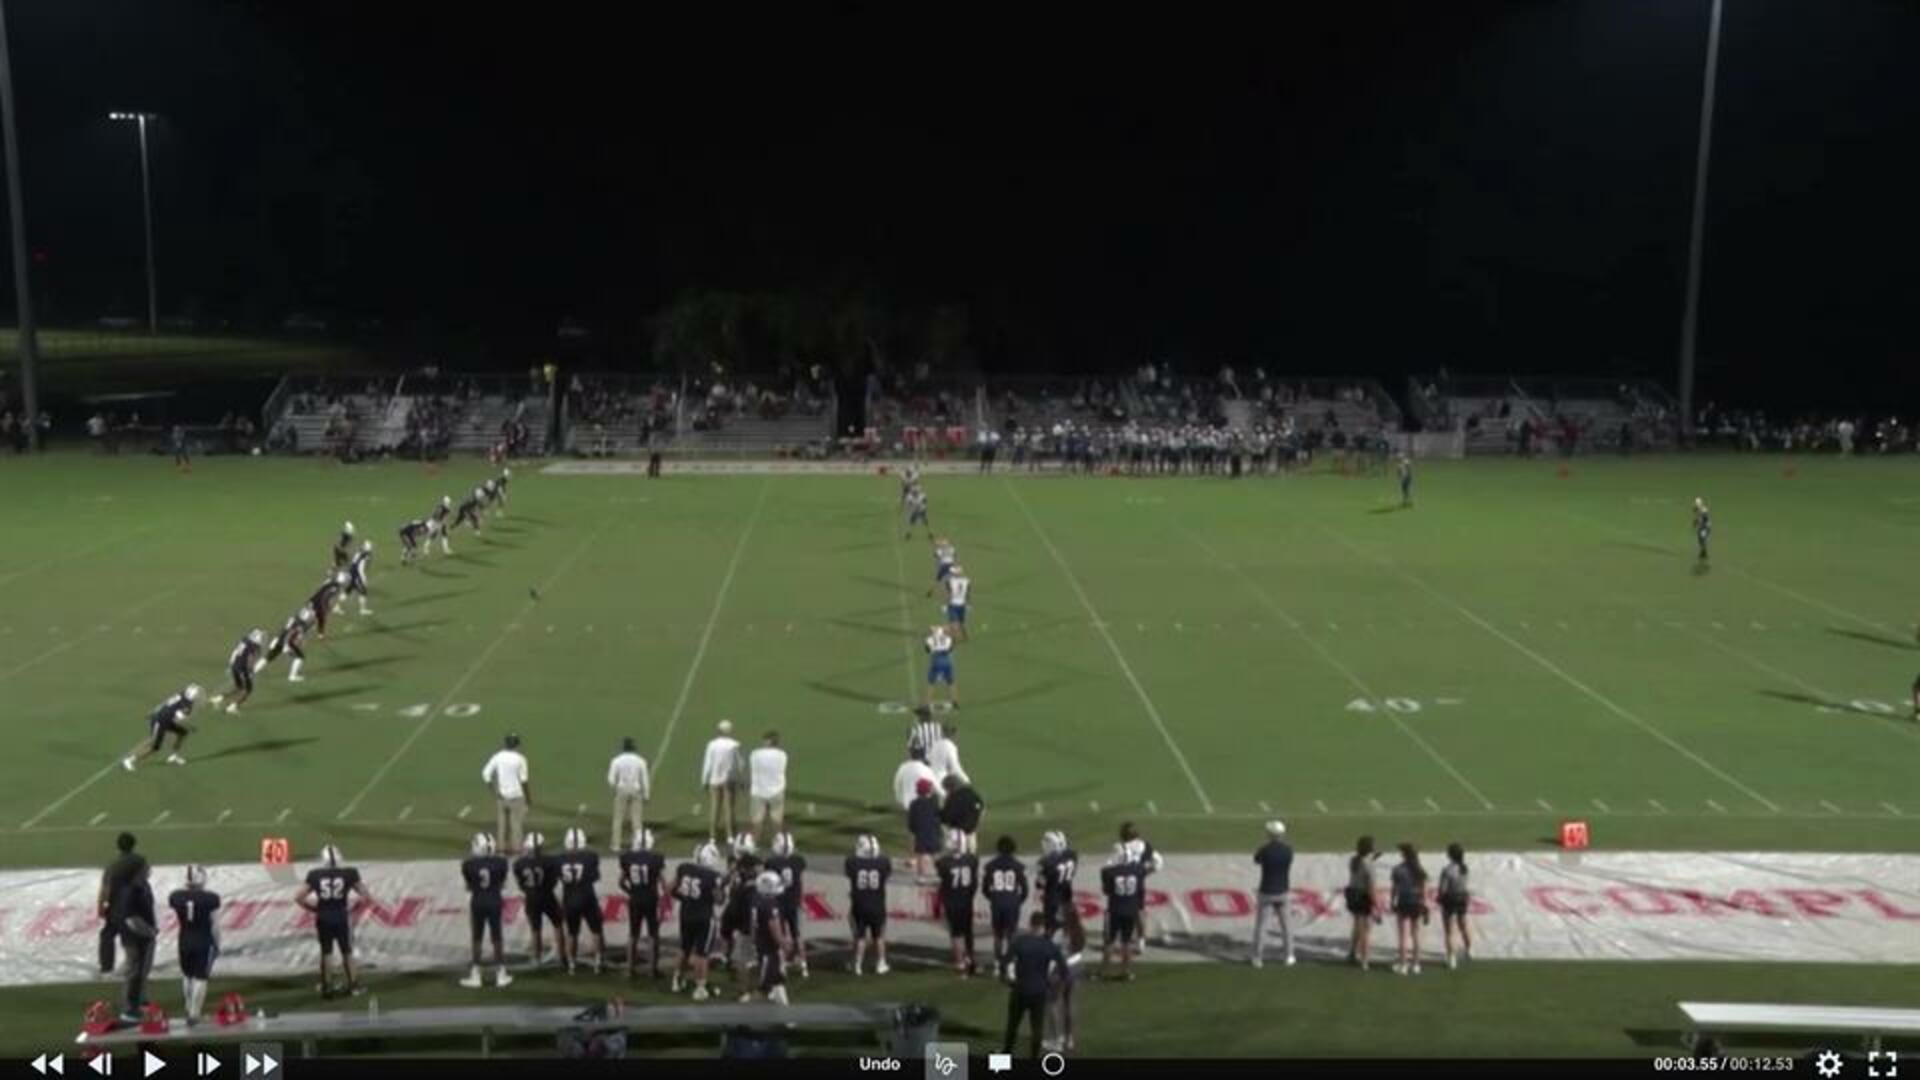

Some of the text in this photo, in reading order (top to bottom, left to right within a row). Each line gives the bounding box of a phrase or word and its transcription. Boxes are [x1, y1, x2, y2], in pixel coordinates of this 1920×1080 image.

[264, 841, 286, 864] 40
[561, 863, 584, 883] 57
[319, 876, 345, 900] 52
[187, 900, 195, 922] 1
